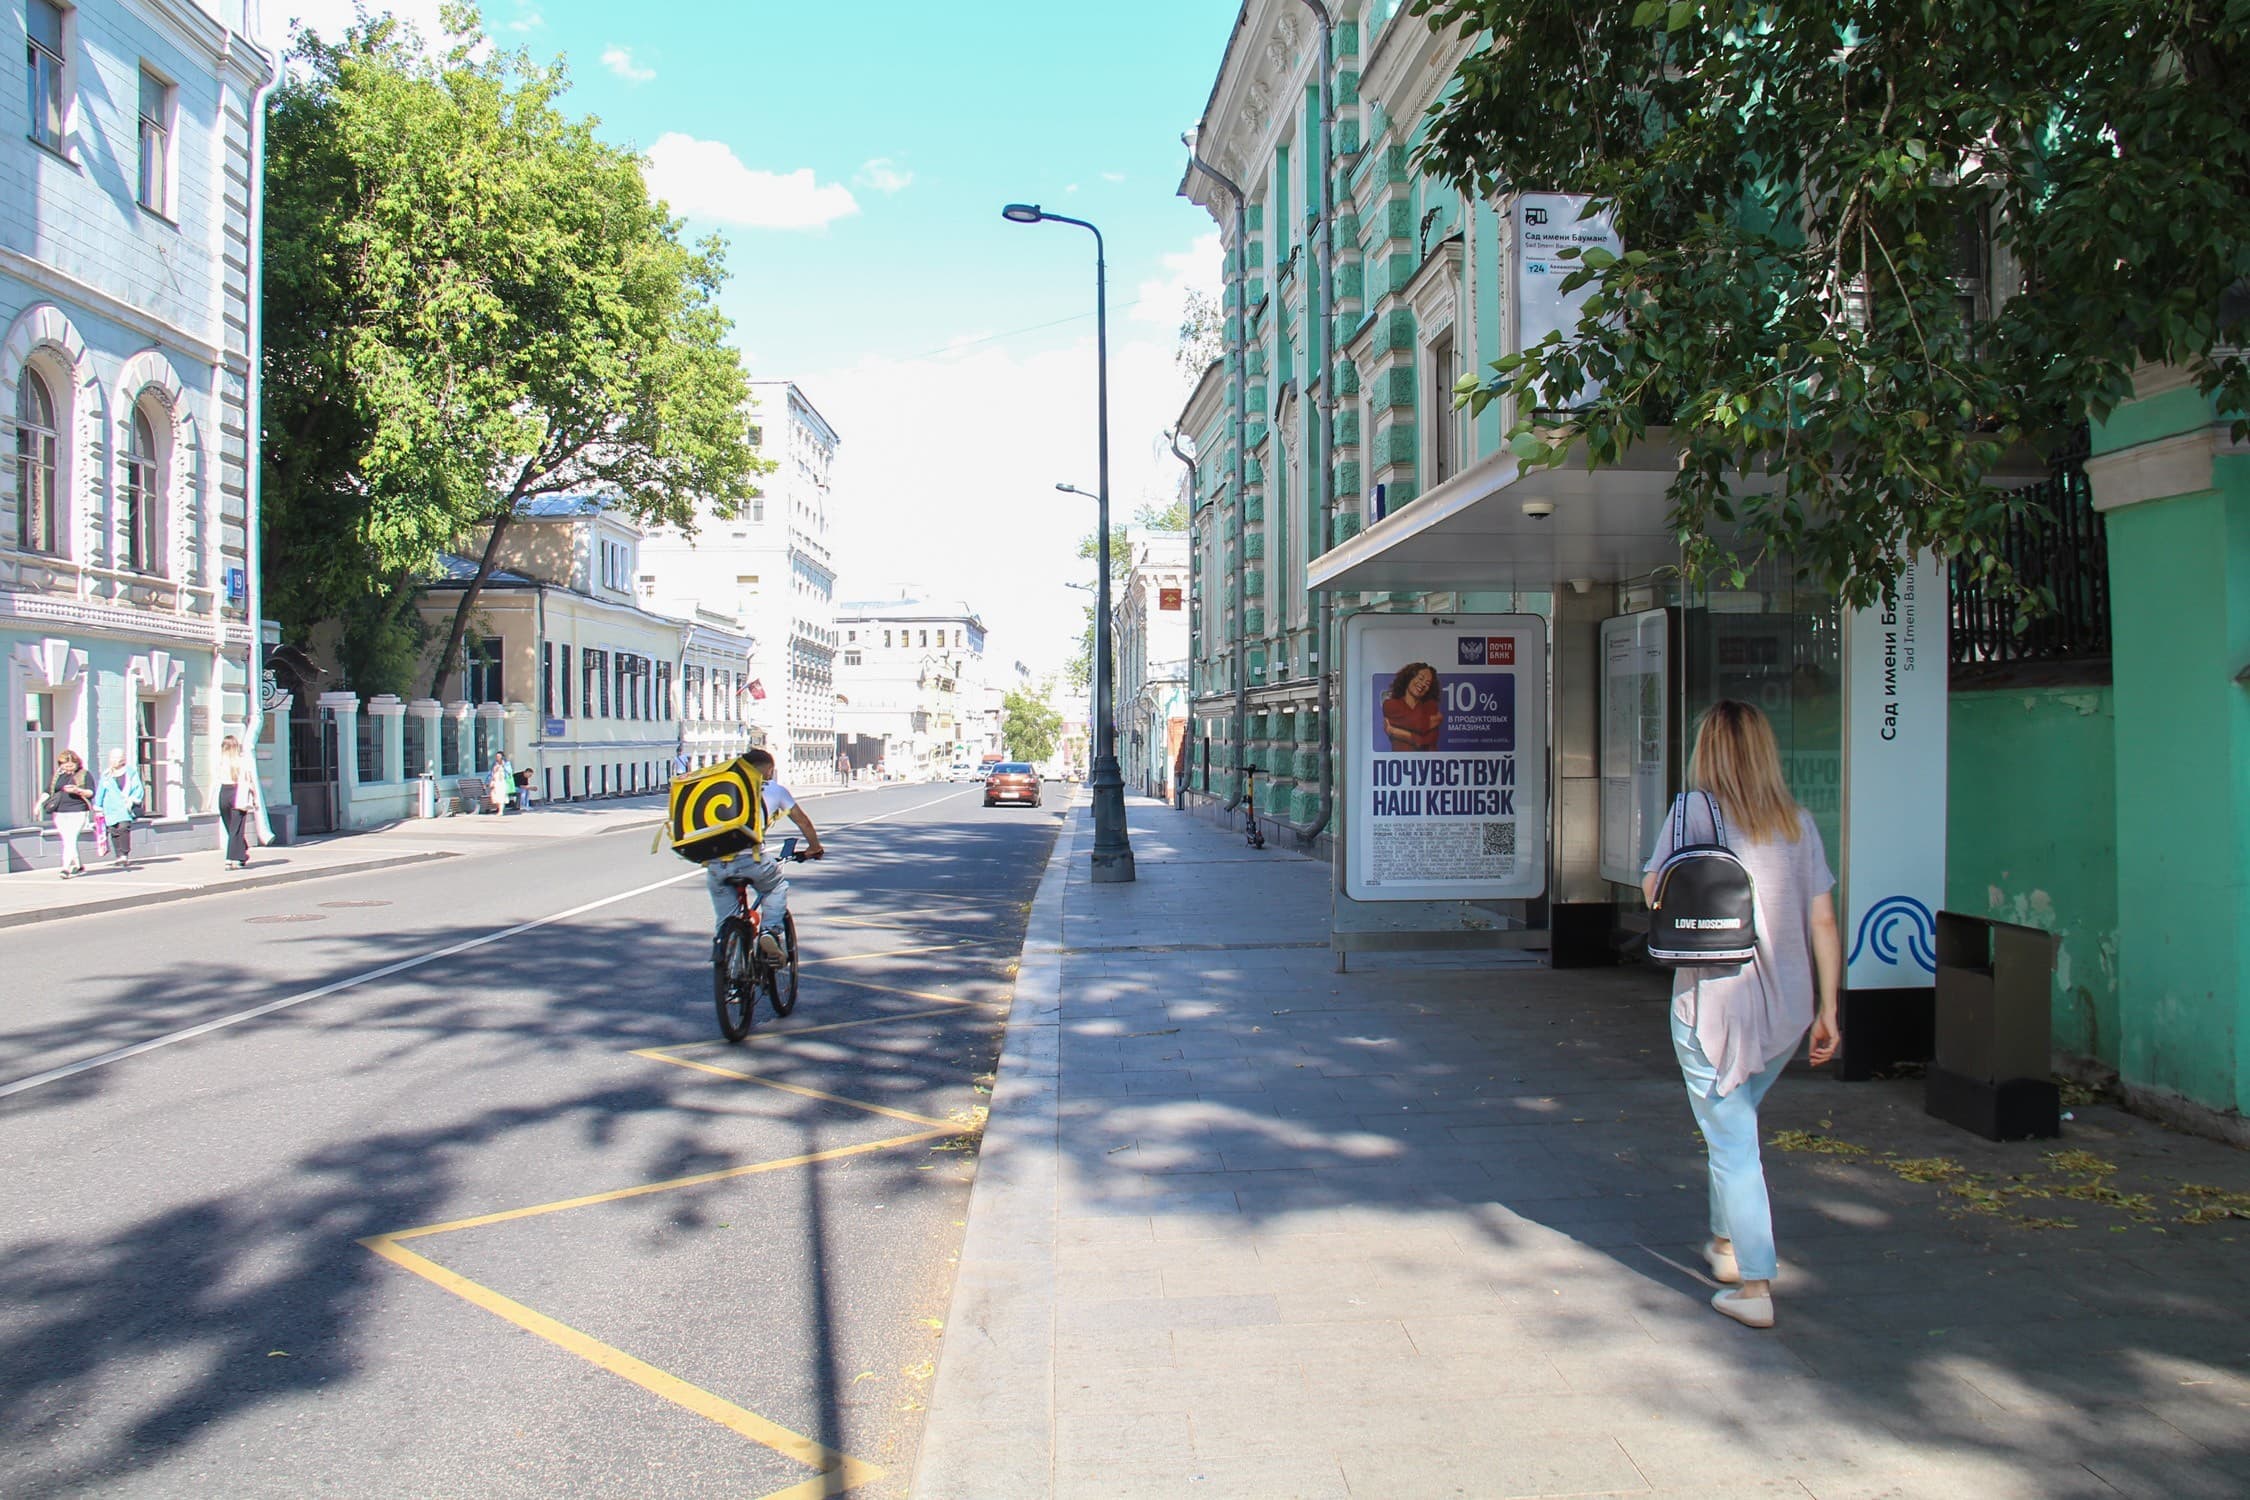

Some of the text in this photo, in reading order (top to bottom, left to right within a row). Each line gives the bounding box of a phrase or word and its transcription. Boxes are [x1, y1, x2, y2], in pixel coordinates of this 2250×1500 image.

[1524, 232, 1540, 241] Сад
[1543, 233, 1570, 241] имени
[1904, 605, 1914, 643] Imeni
[1489, 643, 1513, 651] ПОЧТА
[1489, 651, 1510, 659] БАНК
[1904, 647, 1914, 671] Sad
[1884, 632, 1896, 695] имени
[1442, 682, 1498, 711] 10 %
[1881, 703, 1899, 740] Сад
[1373, 755, 1515, 786] ПОЧУВСТВУЙ
[1373, 789, 1514, 816] НАШ КЕШБЭК
[1675, 918, 1697, 929] LOVE
